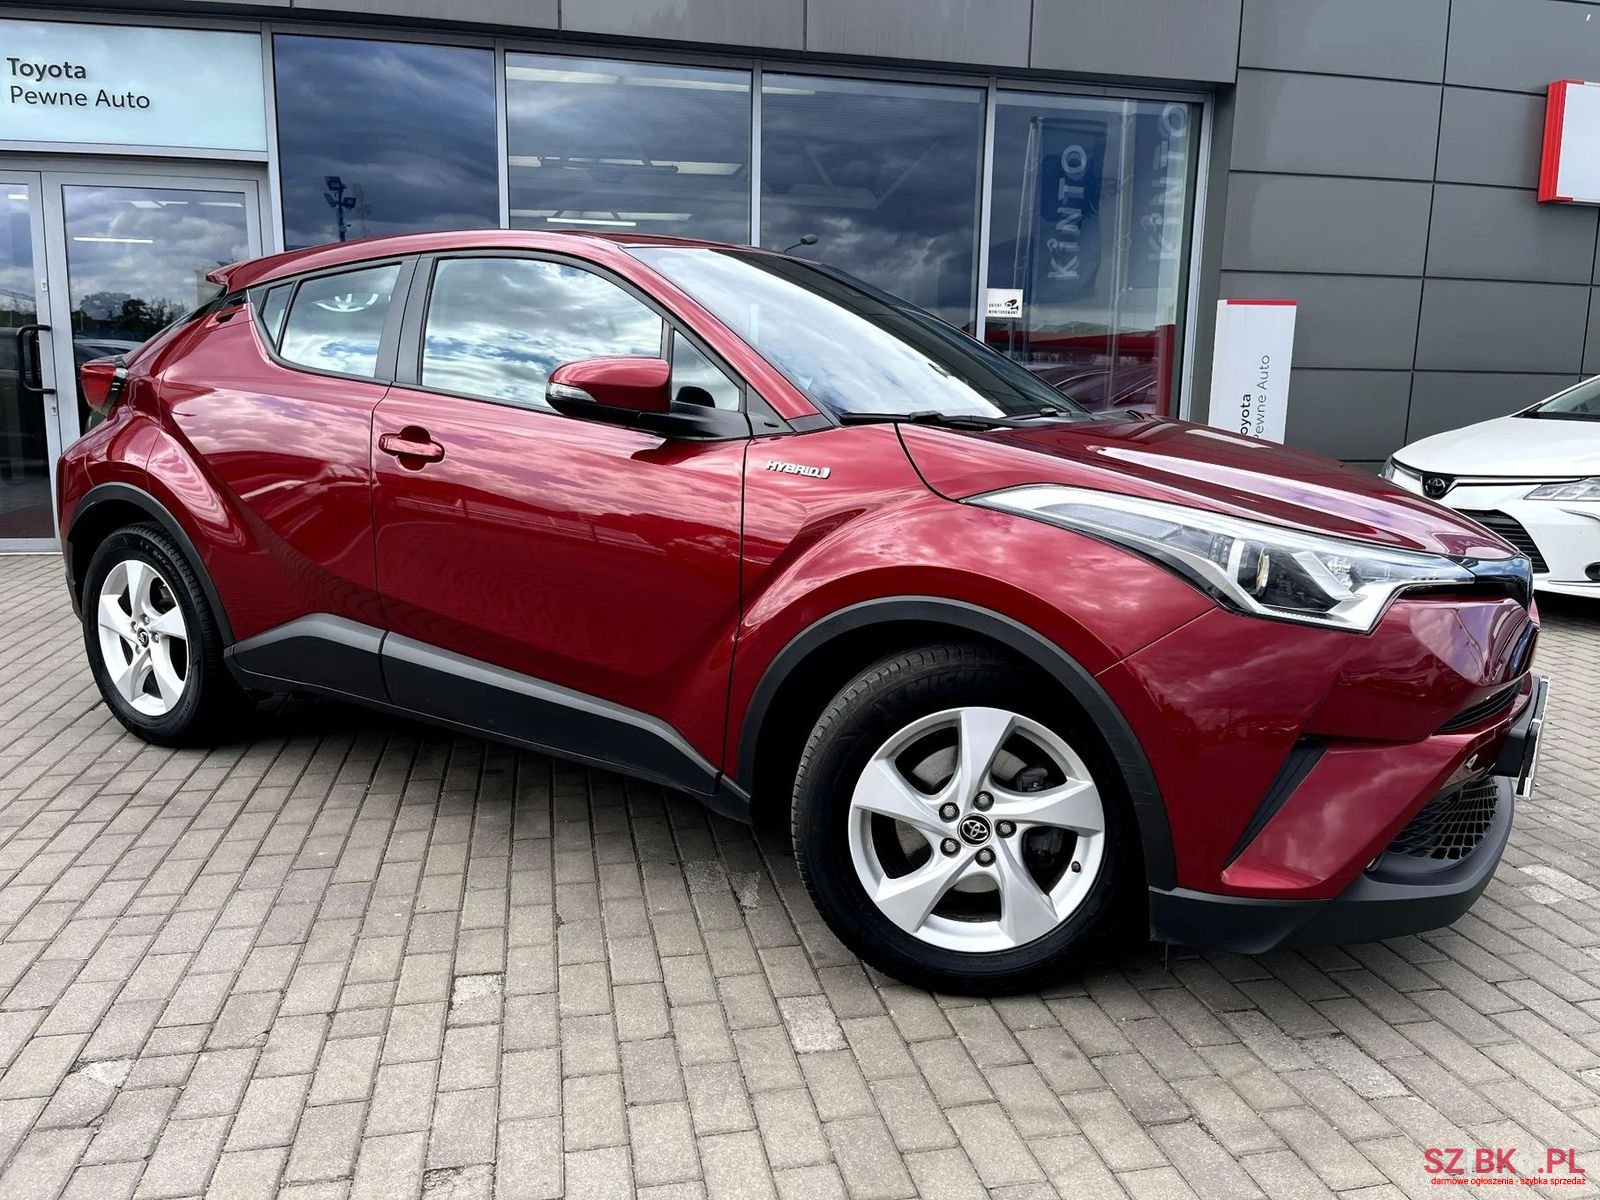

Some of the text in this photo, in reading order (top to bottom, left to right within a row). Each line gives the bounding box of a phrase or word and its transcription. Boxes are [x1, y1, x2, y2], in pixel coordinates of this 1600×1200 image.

[6, 57, 87, 82] Toyota
[10, 85, 151, 109] Pewne Auto
[1256, 354, 1270, 391] Auto
[1240, 393, 1252, 436] oyota
[766, 460, 820, 478] HYBRID
